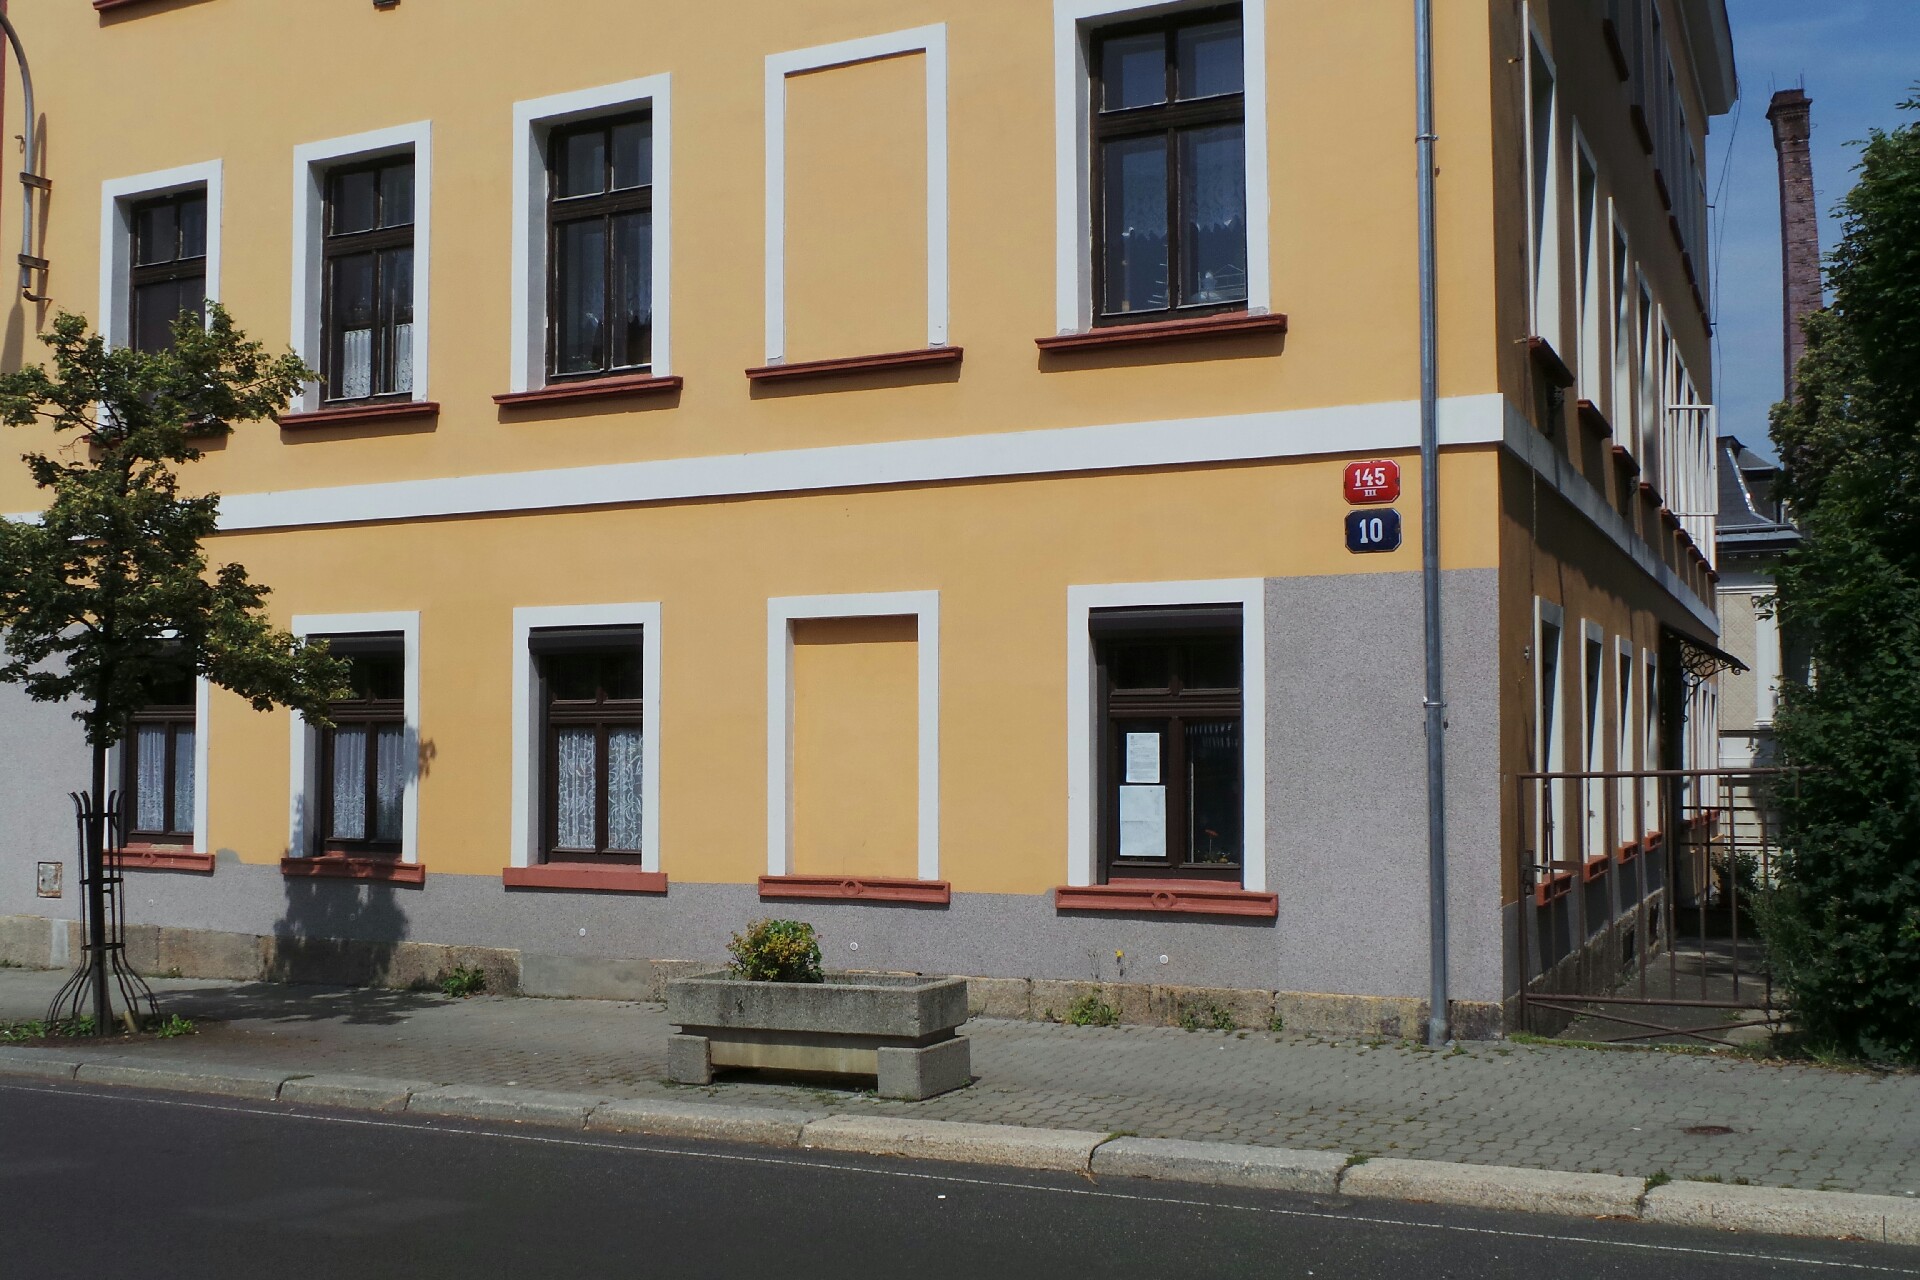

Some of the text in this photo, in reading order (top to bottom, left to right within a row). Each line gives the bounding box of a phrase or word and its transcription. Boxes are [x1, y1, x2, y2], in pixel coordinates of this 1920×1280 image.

[1355, 468, 1385, 487] 145
[1364, 489, 1377, 497] III
[1359, 518, 1383, 544] 10
